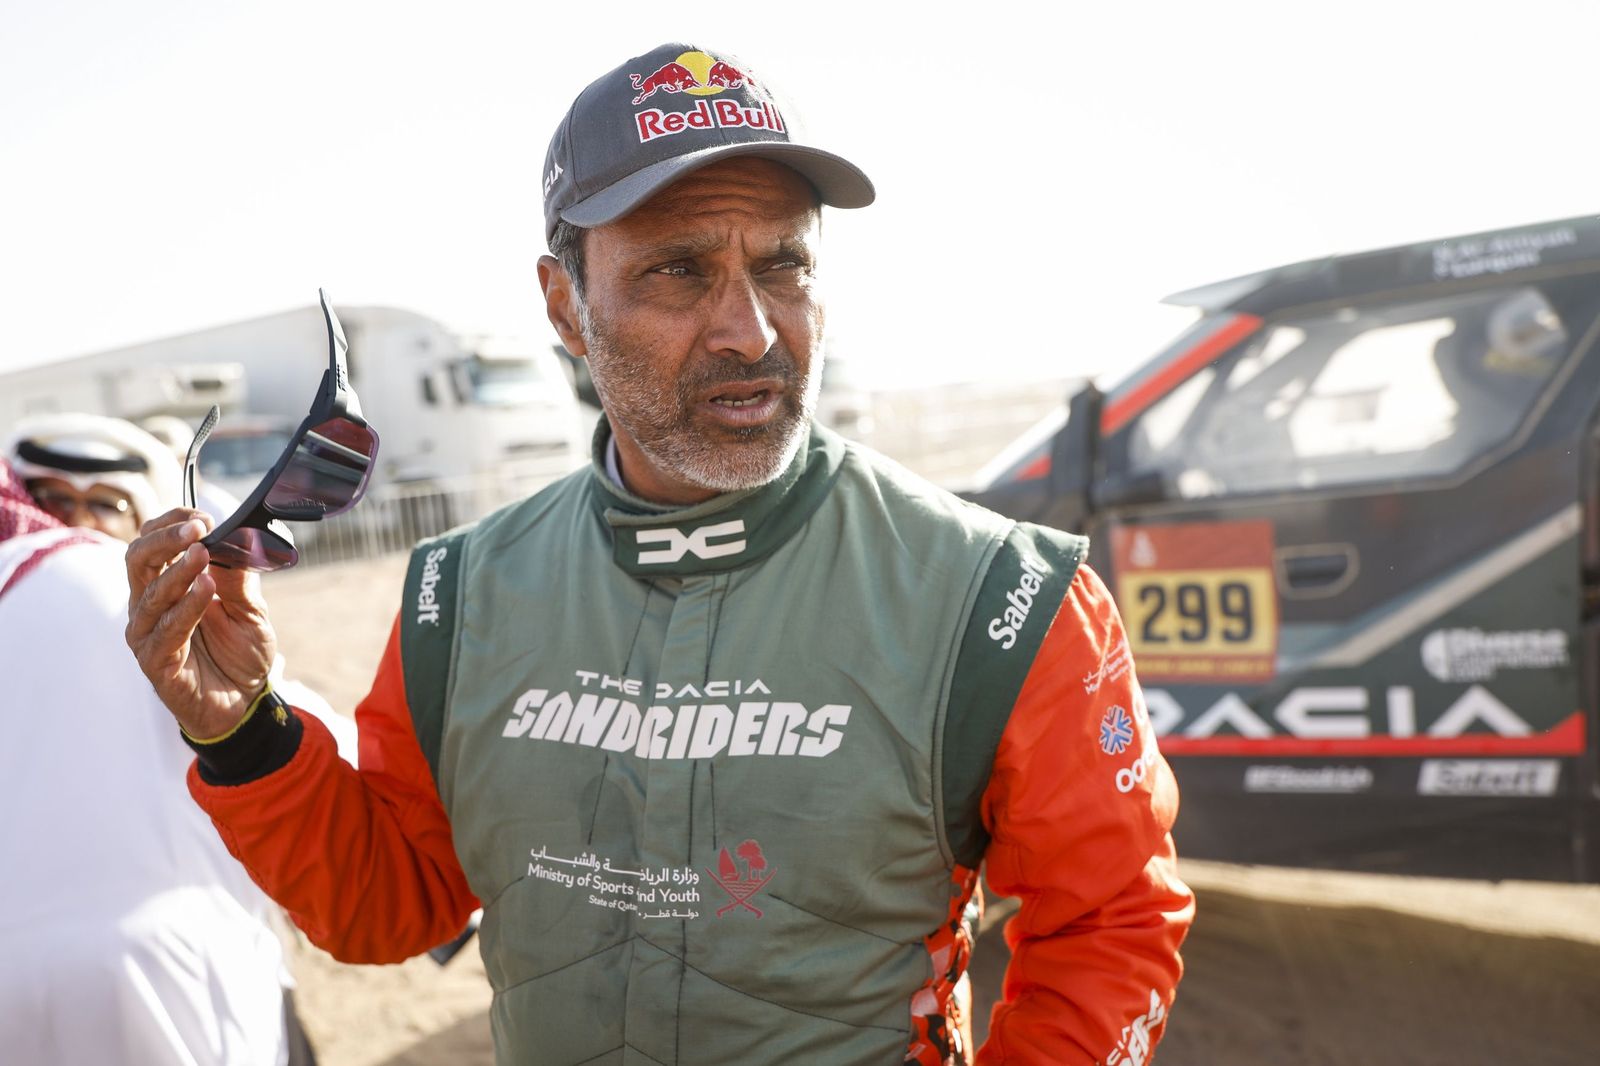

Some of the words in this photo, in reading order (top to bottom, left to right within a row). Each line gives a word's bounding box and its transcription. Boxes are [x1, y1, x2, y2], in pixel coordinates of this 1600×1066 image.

[636, 101, 713, 141] Red
[714, 100, 784, 133] Bull
[417, 547, 447, 625] Sabelt
[1137, 580, 1254, 643] 299
[576, 670, 643, 696] THE
[655, 678, 772, 699] DACIA
[502, 689, 852, 759] SANDRIDERS
[530, 845, 601, 872] والشباب
[528, 862, 574, 888] Ministry
[576, 873, 592, 887] of
[592, 875, 634, 895] Sports
[659, 887, 700, 903] Youth
[671, 867, 700, 885] وزارة
[588, 894, 608, 907] State
[608, 899, 618, 908] of
[642, 908, 671, 919] قطر
[671, 908, 700, 919] دولة
[1096, 1026, 1131, 1066] CIA
